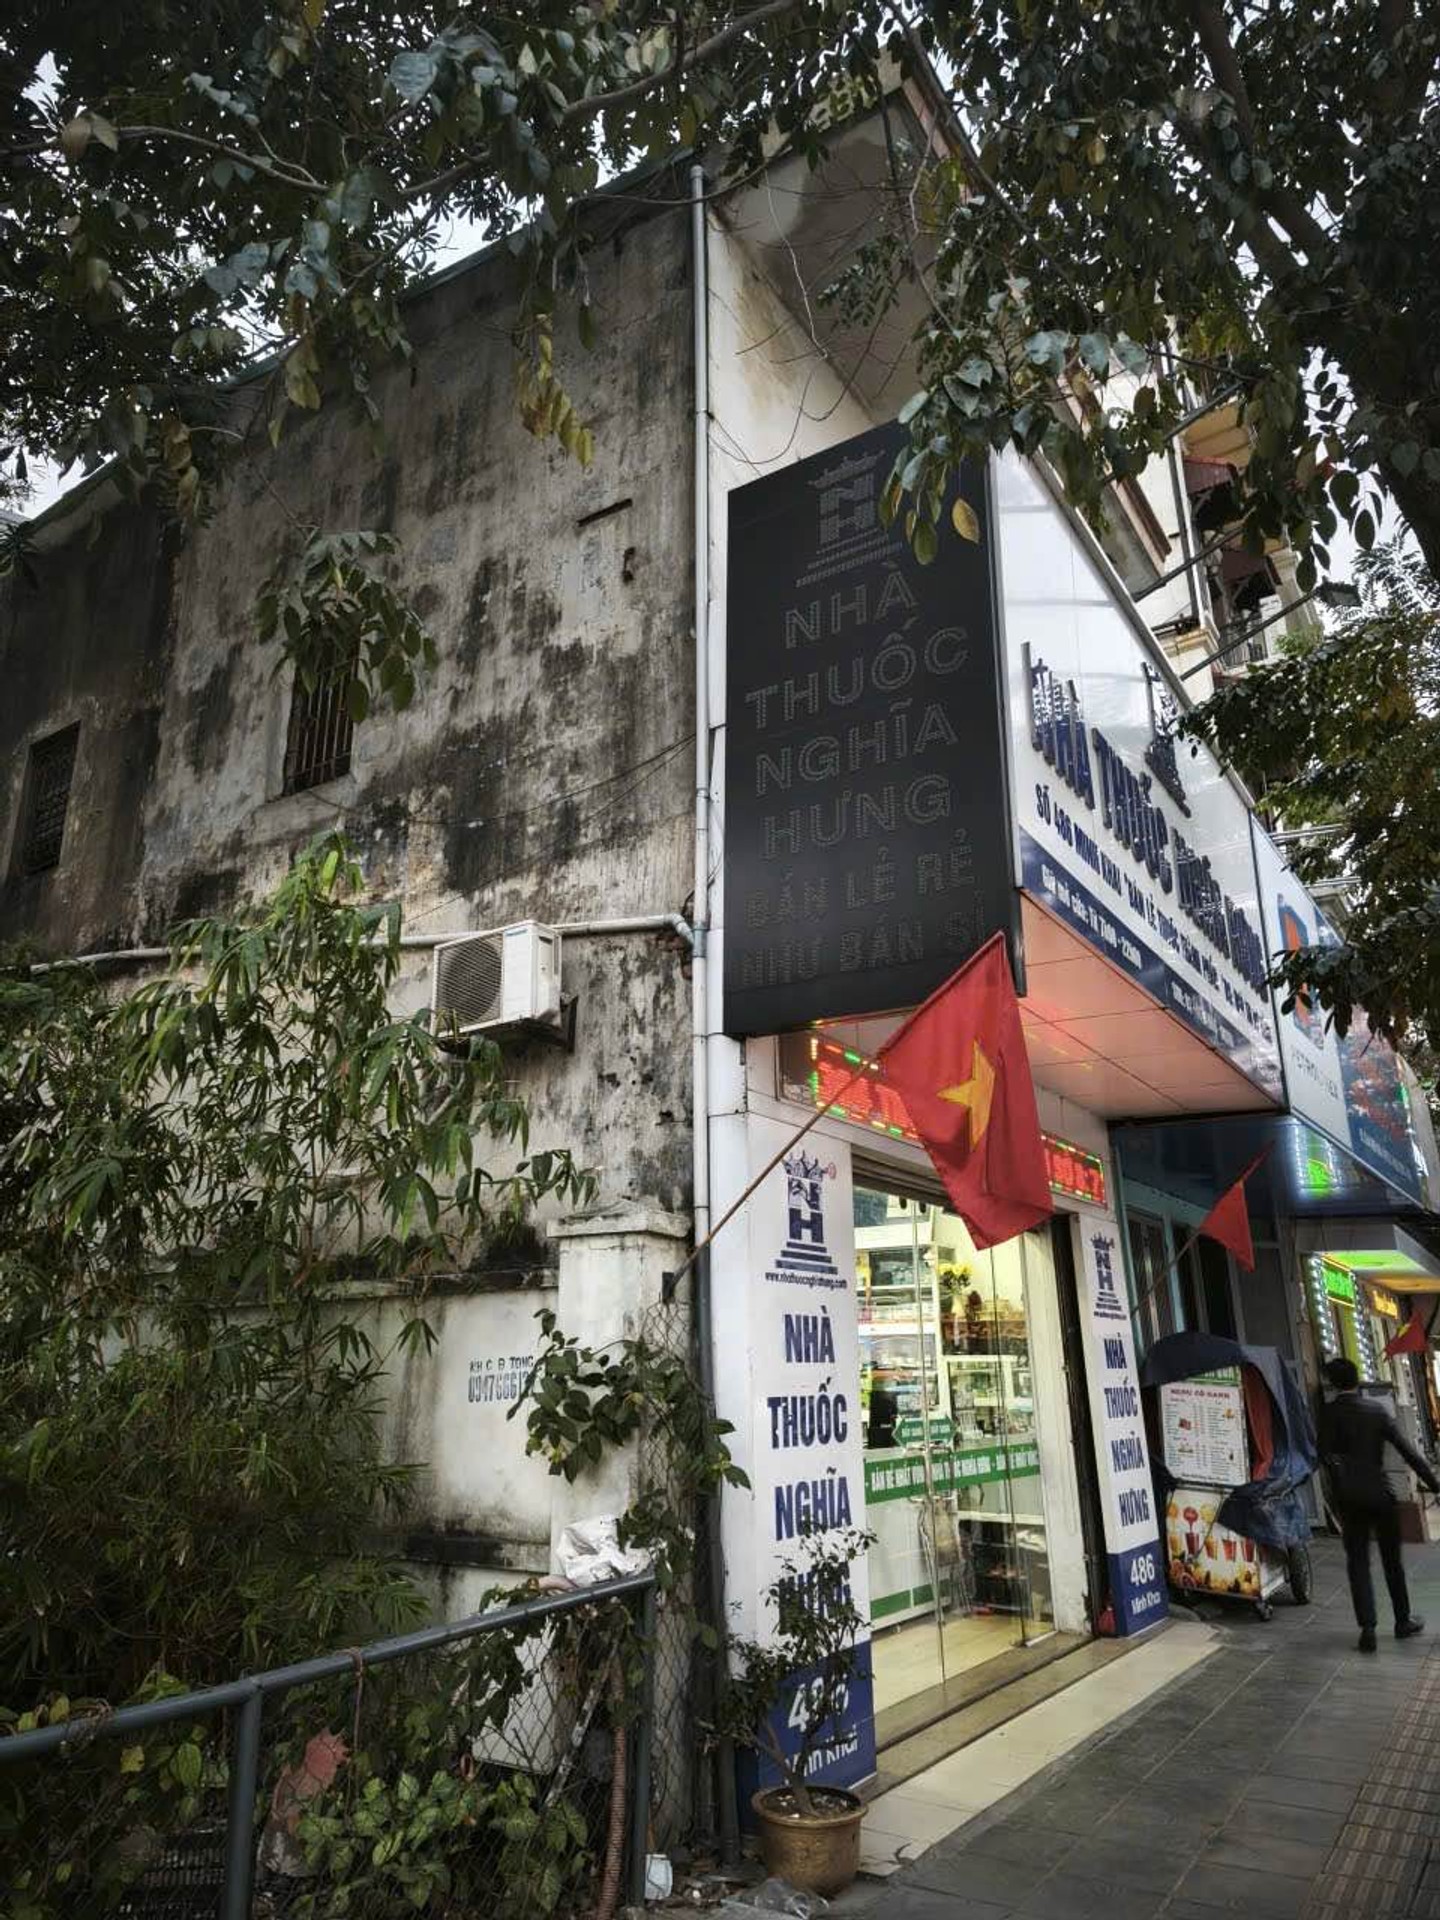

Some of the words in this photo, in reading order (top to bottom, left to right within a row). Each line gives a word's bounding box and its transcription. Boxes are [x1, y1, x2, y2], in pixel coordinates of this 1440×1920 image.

[785, 559, 919, 650] NHÀ
[745, 616, 970, 729] THUỐC
[755, 698, 958, 798] NGHĨA
[762, 773, 950, 863] HƯNG
[784, 1305, 835, 1363] NHÀ
[1104, 1332, 1127, 1369] NHÀ
[767, 1377, 848, 1449] THUỐC
[1104, 1376, 1138, 1419] THUỐC
[1111, 1430, 1145, 1472] NGHĨA
[775, 1466, 853, 1541] NGHĨA
[1118, 1488, 1150, 1527] HƯNG
[1131, 1553, 1155, 1587] 486
